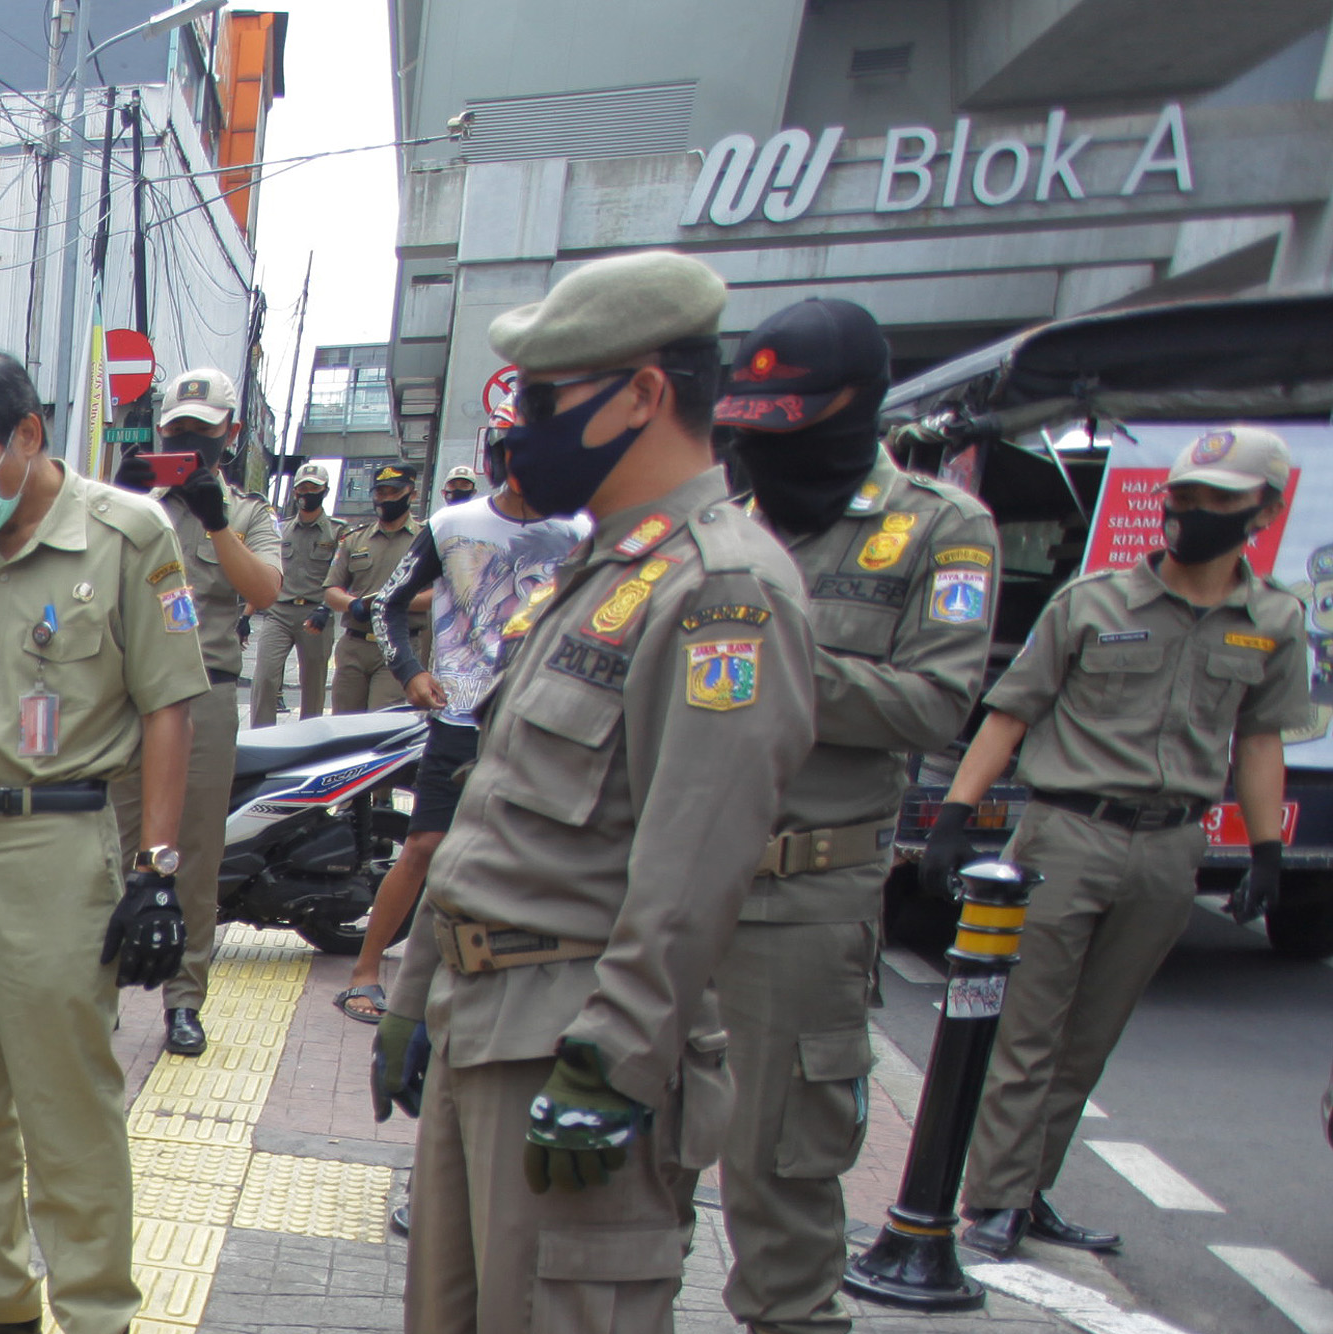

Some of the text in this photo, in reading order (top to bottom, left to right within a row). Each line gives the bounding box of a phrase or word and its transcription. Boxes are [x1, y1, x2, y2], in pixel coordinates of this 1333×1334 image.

[875, 109, 1093, 213] Blok
[1121, 102, 1194, 196] A
[1121, 481, 1148, 493] HAI
[1112, 533, 1145, 546] KITA
